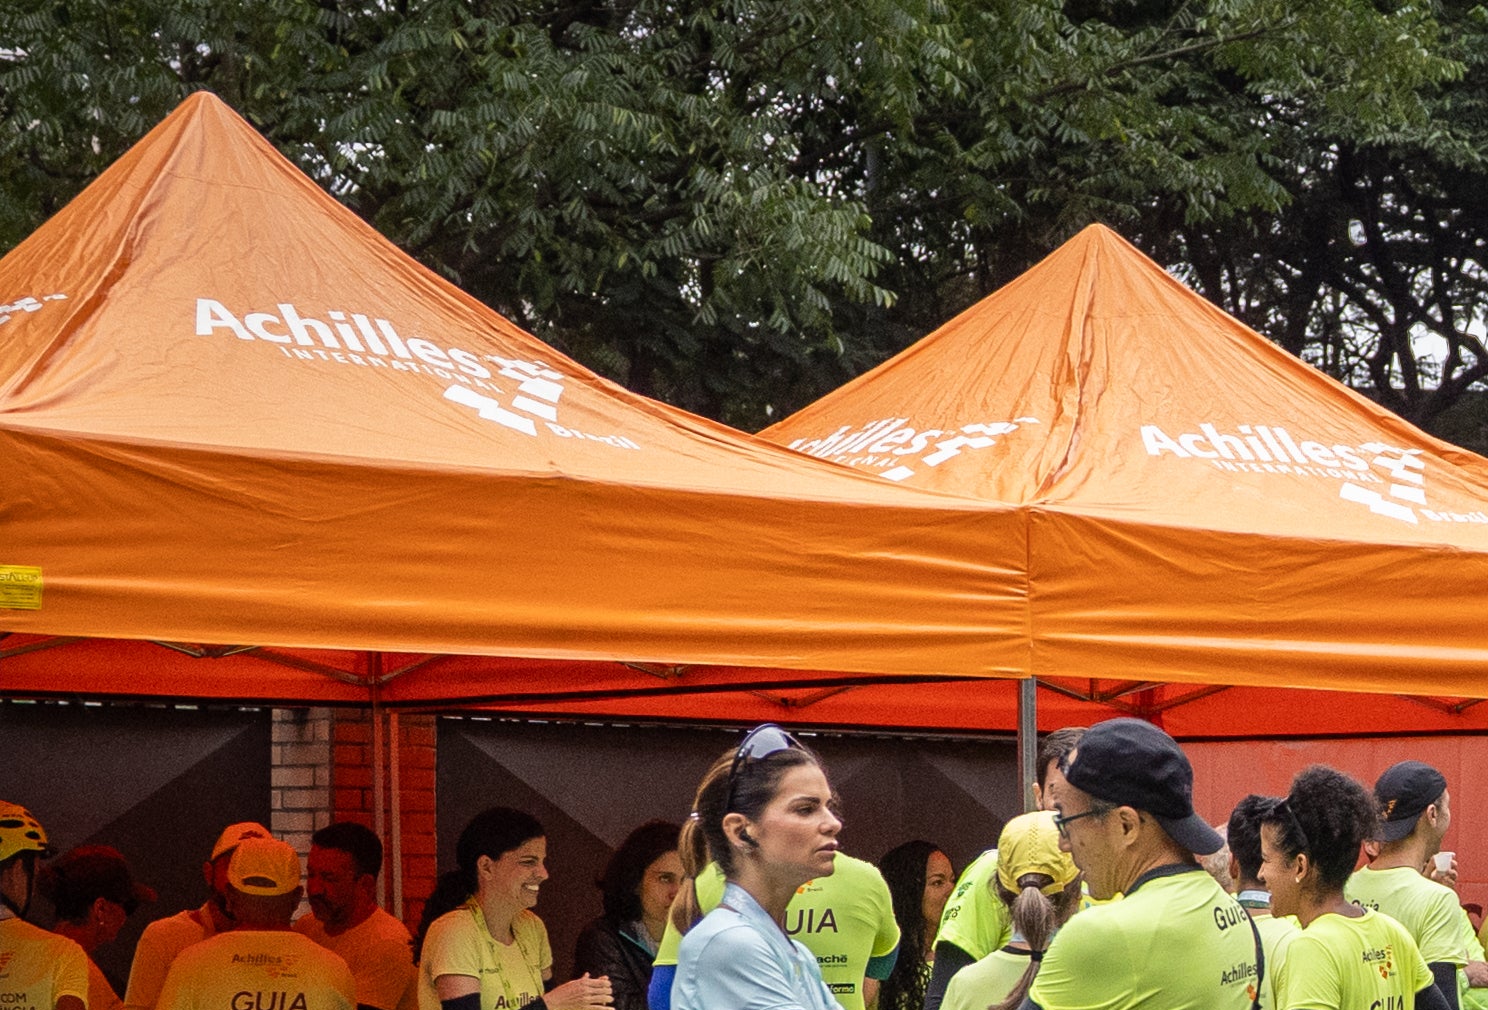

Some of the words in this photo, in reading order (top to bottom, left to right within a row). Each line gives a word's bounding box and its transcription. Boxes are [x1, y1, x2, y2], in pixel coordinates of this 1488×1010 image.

[194, 298, 491, 378] Achilles
[280, 346, 504, 394] INTERNATIONAL
[1139, 422, 1370, 472] Achilles
[785, 908, 838, 935] UIA
[1213, 906, 1248, 931] Guia
[1220, 962, 1258, 986] Achilles
